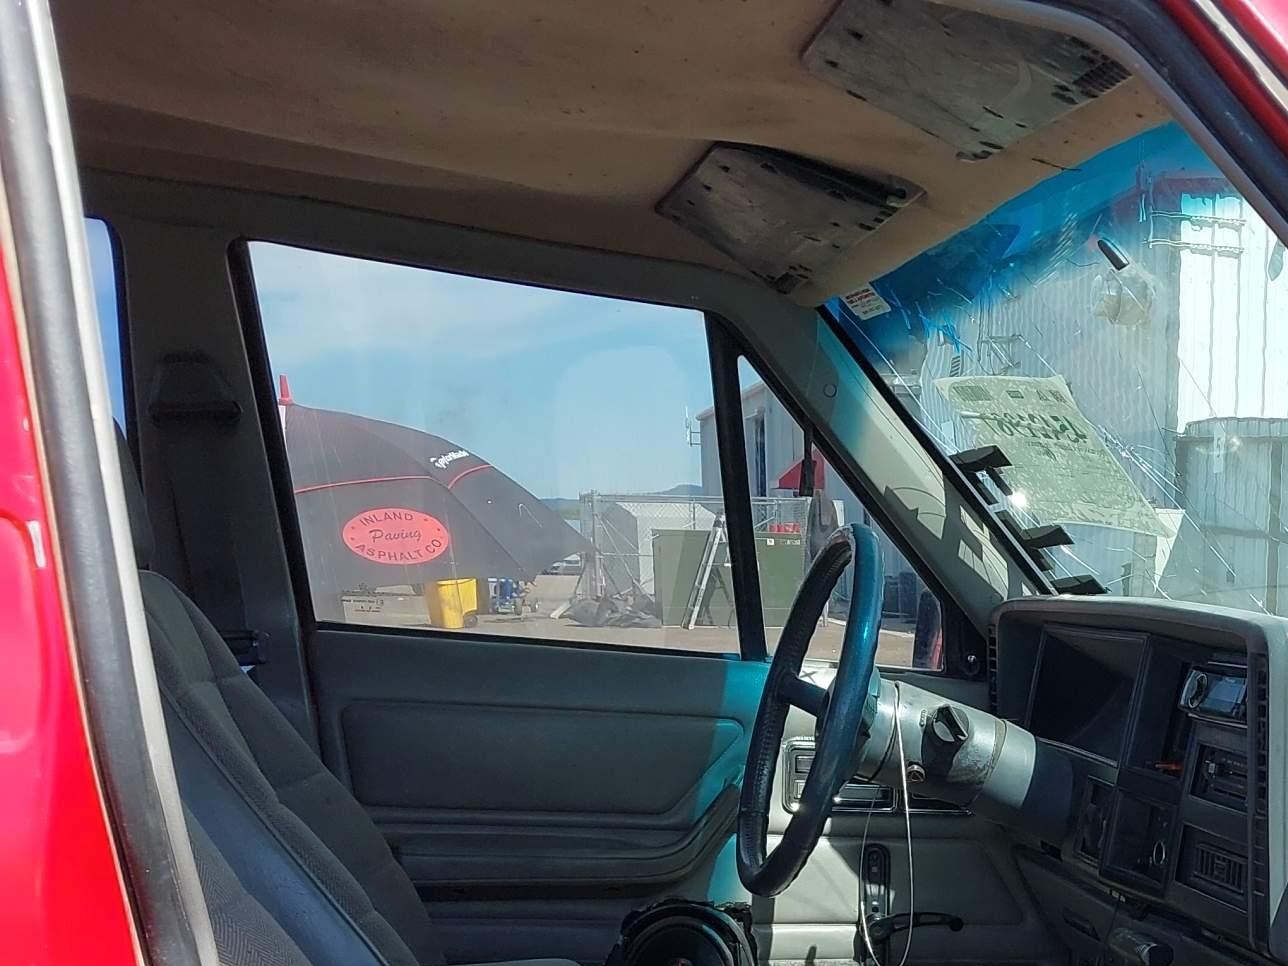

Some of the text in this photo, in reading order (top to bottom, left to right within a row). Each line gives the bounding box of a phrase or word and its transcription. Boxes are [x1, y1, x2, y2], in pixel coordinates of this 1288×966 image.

[359, 511, 414, 526] INLAND
[369, 528, 422, 543] Paving
[354, 538, 442, 561] ASPHALT CO
